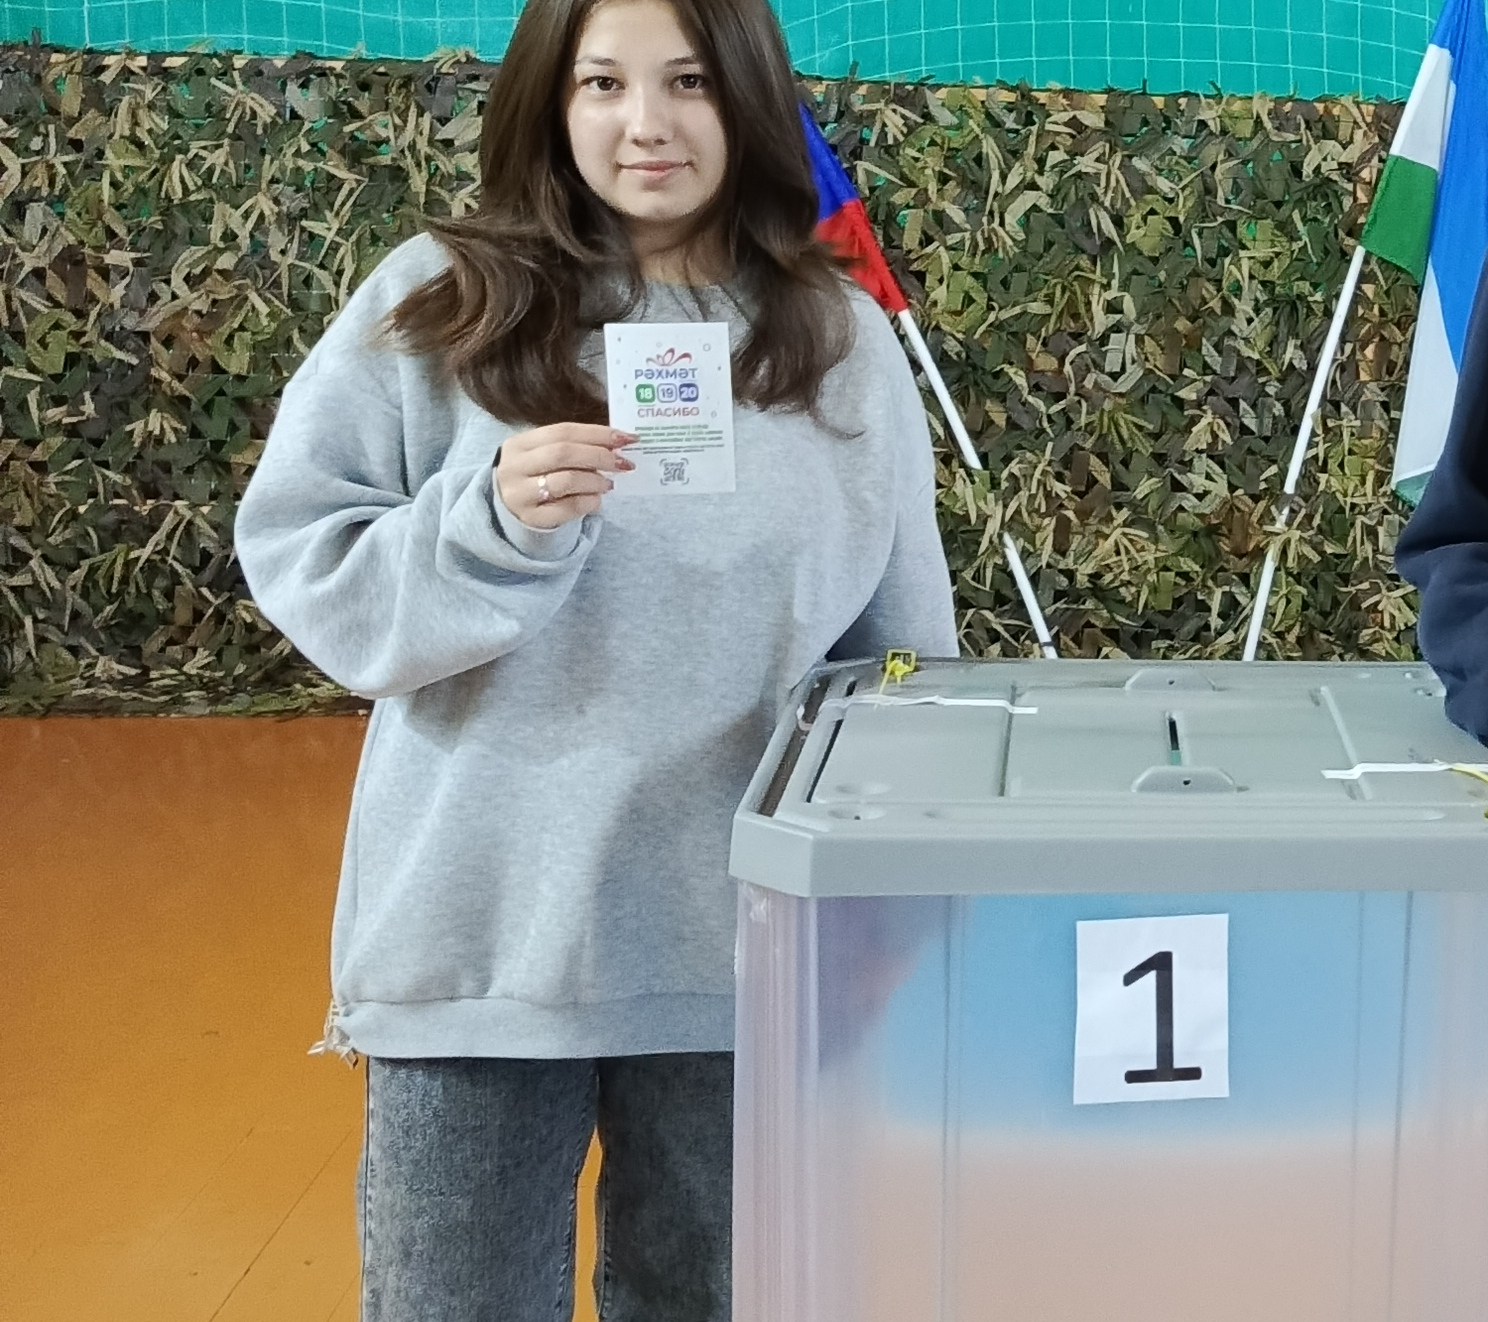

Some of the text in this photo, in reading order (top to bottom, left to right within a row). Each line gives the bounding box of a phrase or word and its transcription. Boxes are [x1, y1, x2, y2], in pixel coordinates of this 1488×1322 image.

[634, 367, 699, 380] РӘХМӘТ
[638, 387, 697, 400] 18 19 20
[637, 406, 700, 418] СПАСИБО
[1123, 950, 1202, 1085] 1
